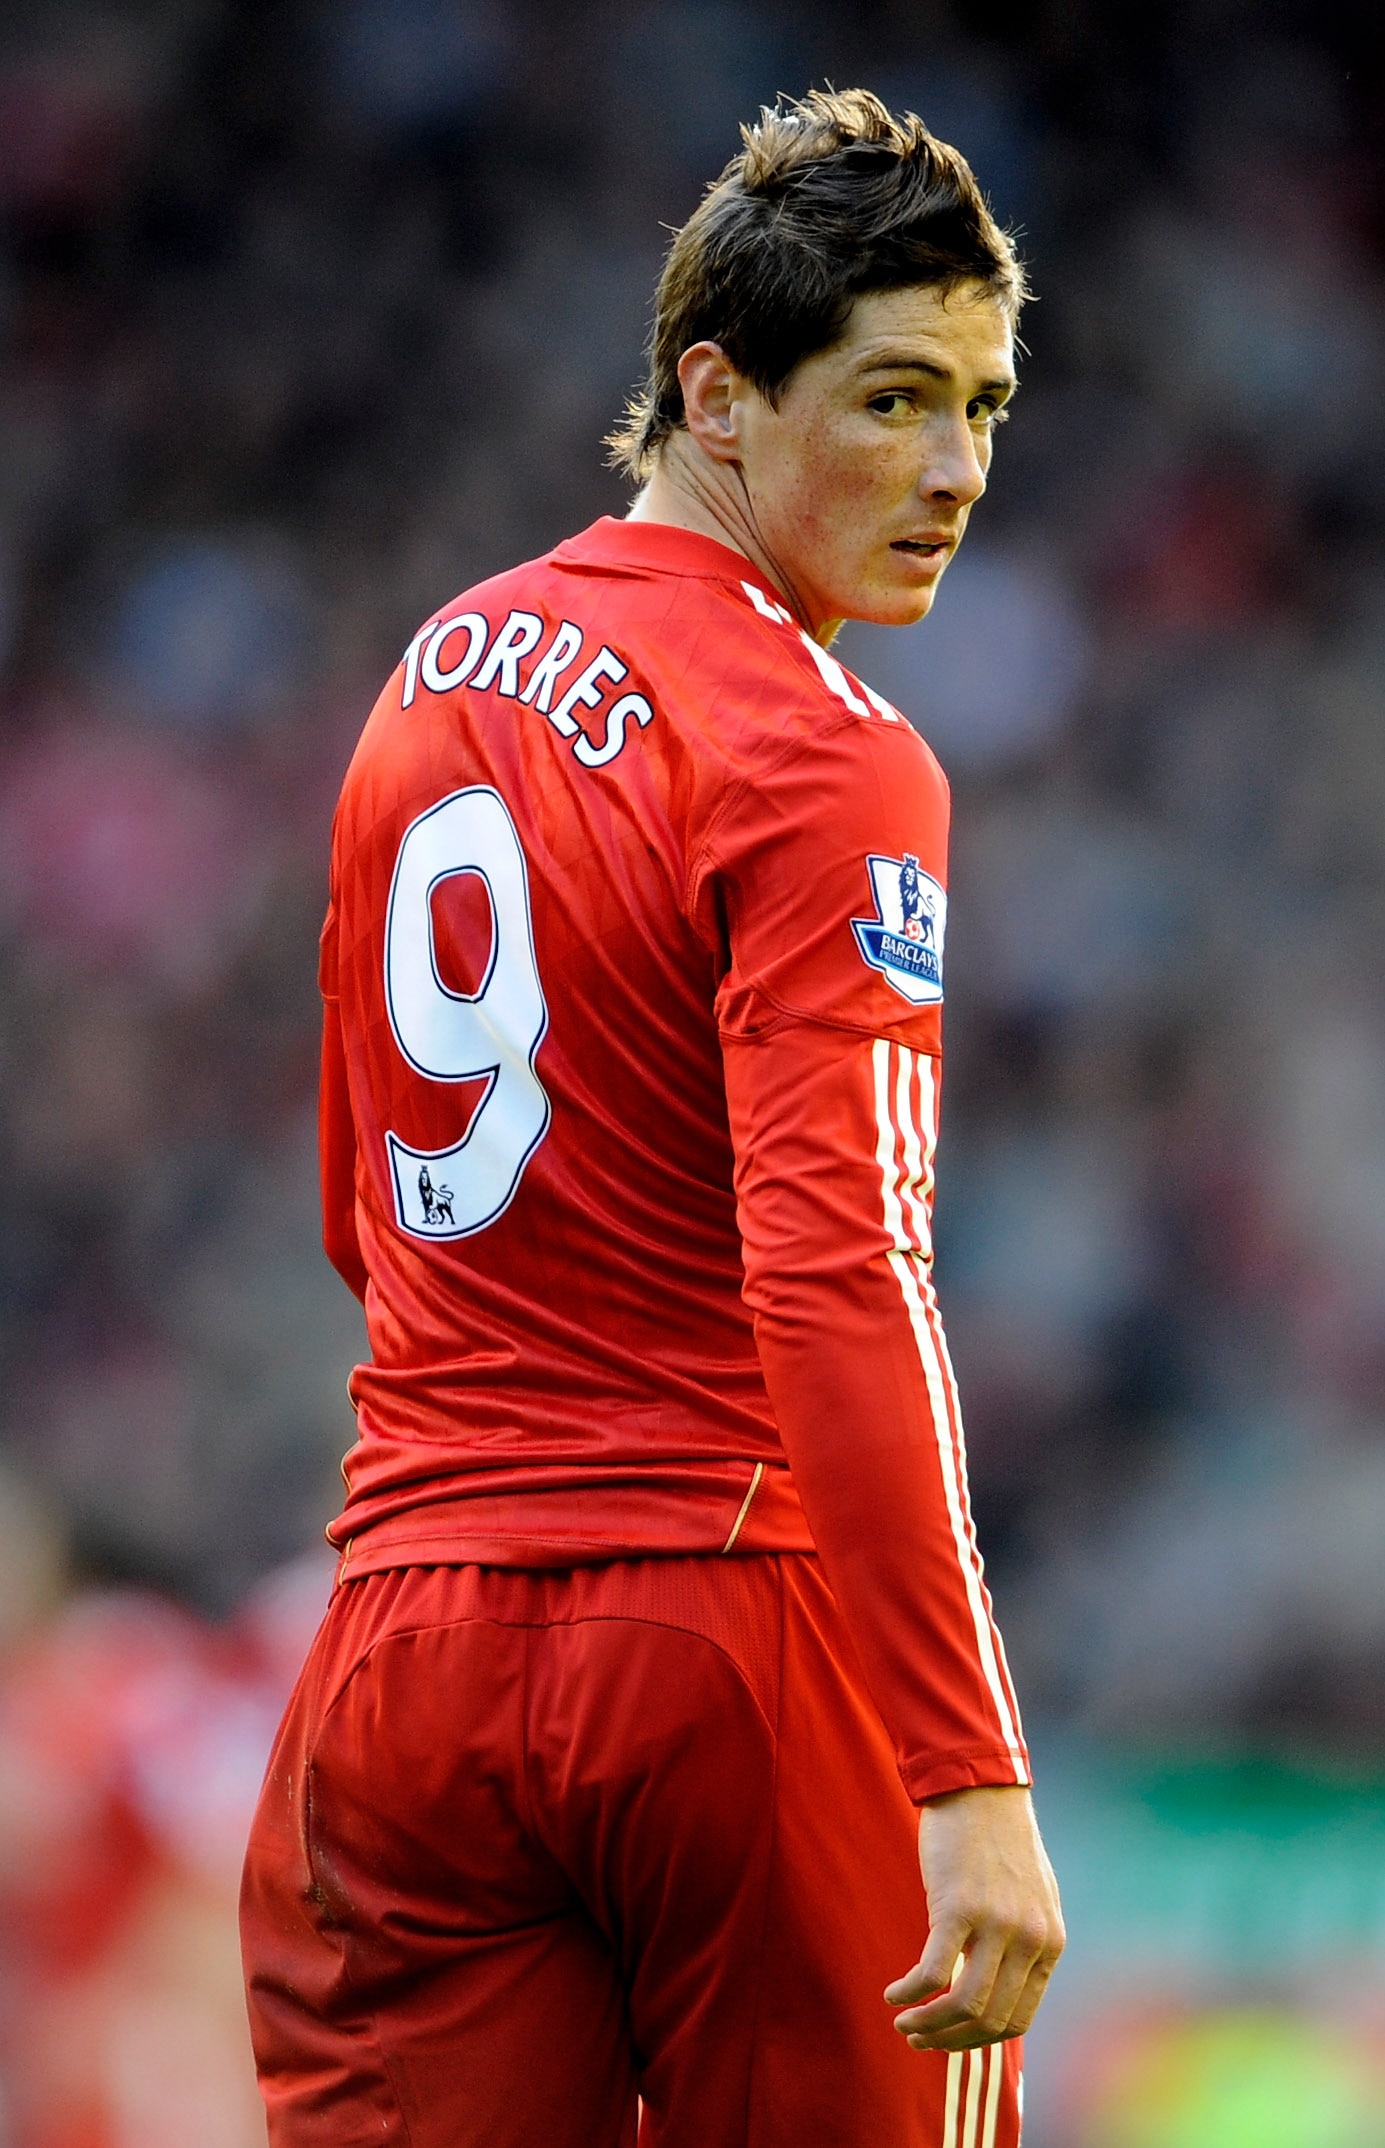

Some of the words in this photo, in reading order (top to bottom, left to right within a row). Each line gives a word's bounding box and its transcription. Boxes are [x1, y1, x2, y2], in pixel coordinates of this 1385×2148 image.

[401, 610, 654, 768] TORRES
[384, 785, 551, 1242] 9
[881, 934, 938, 972] BARCLAYS
